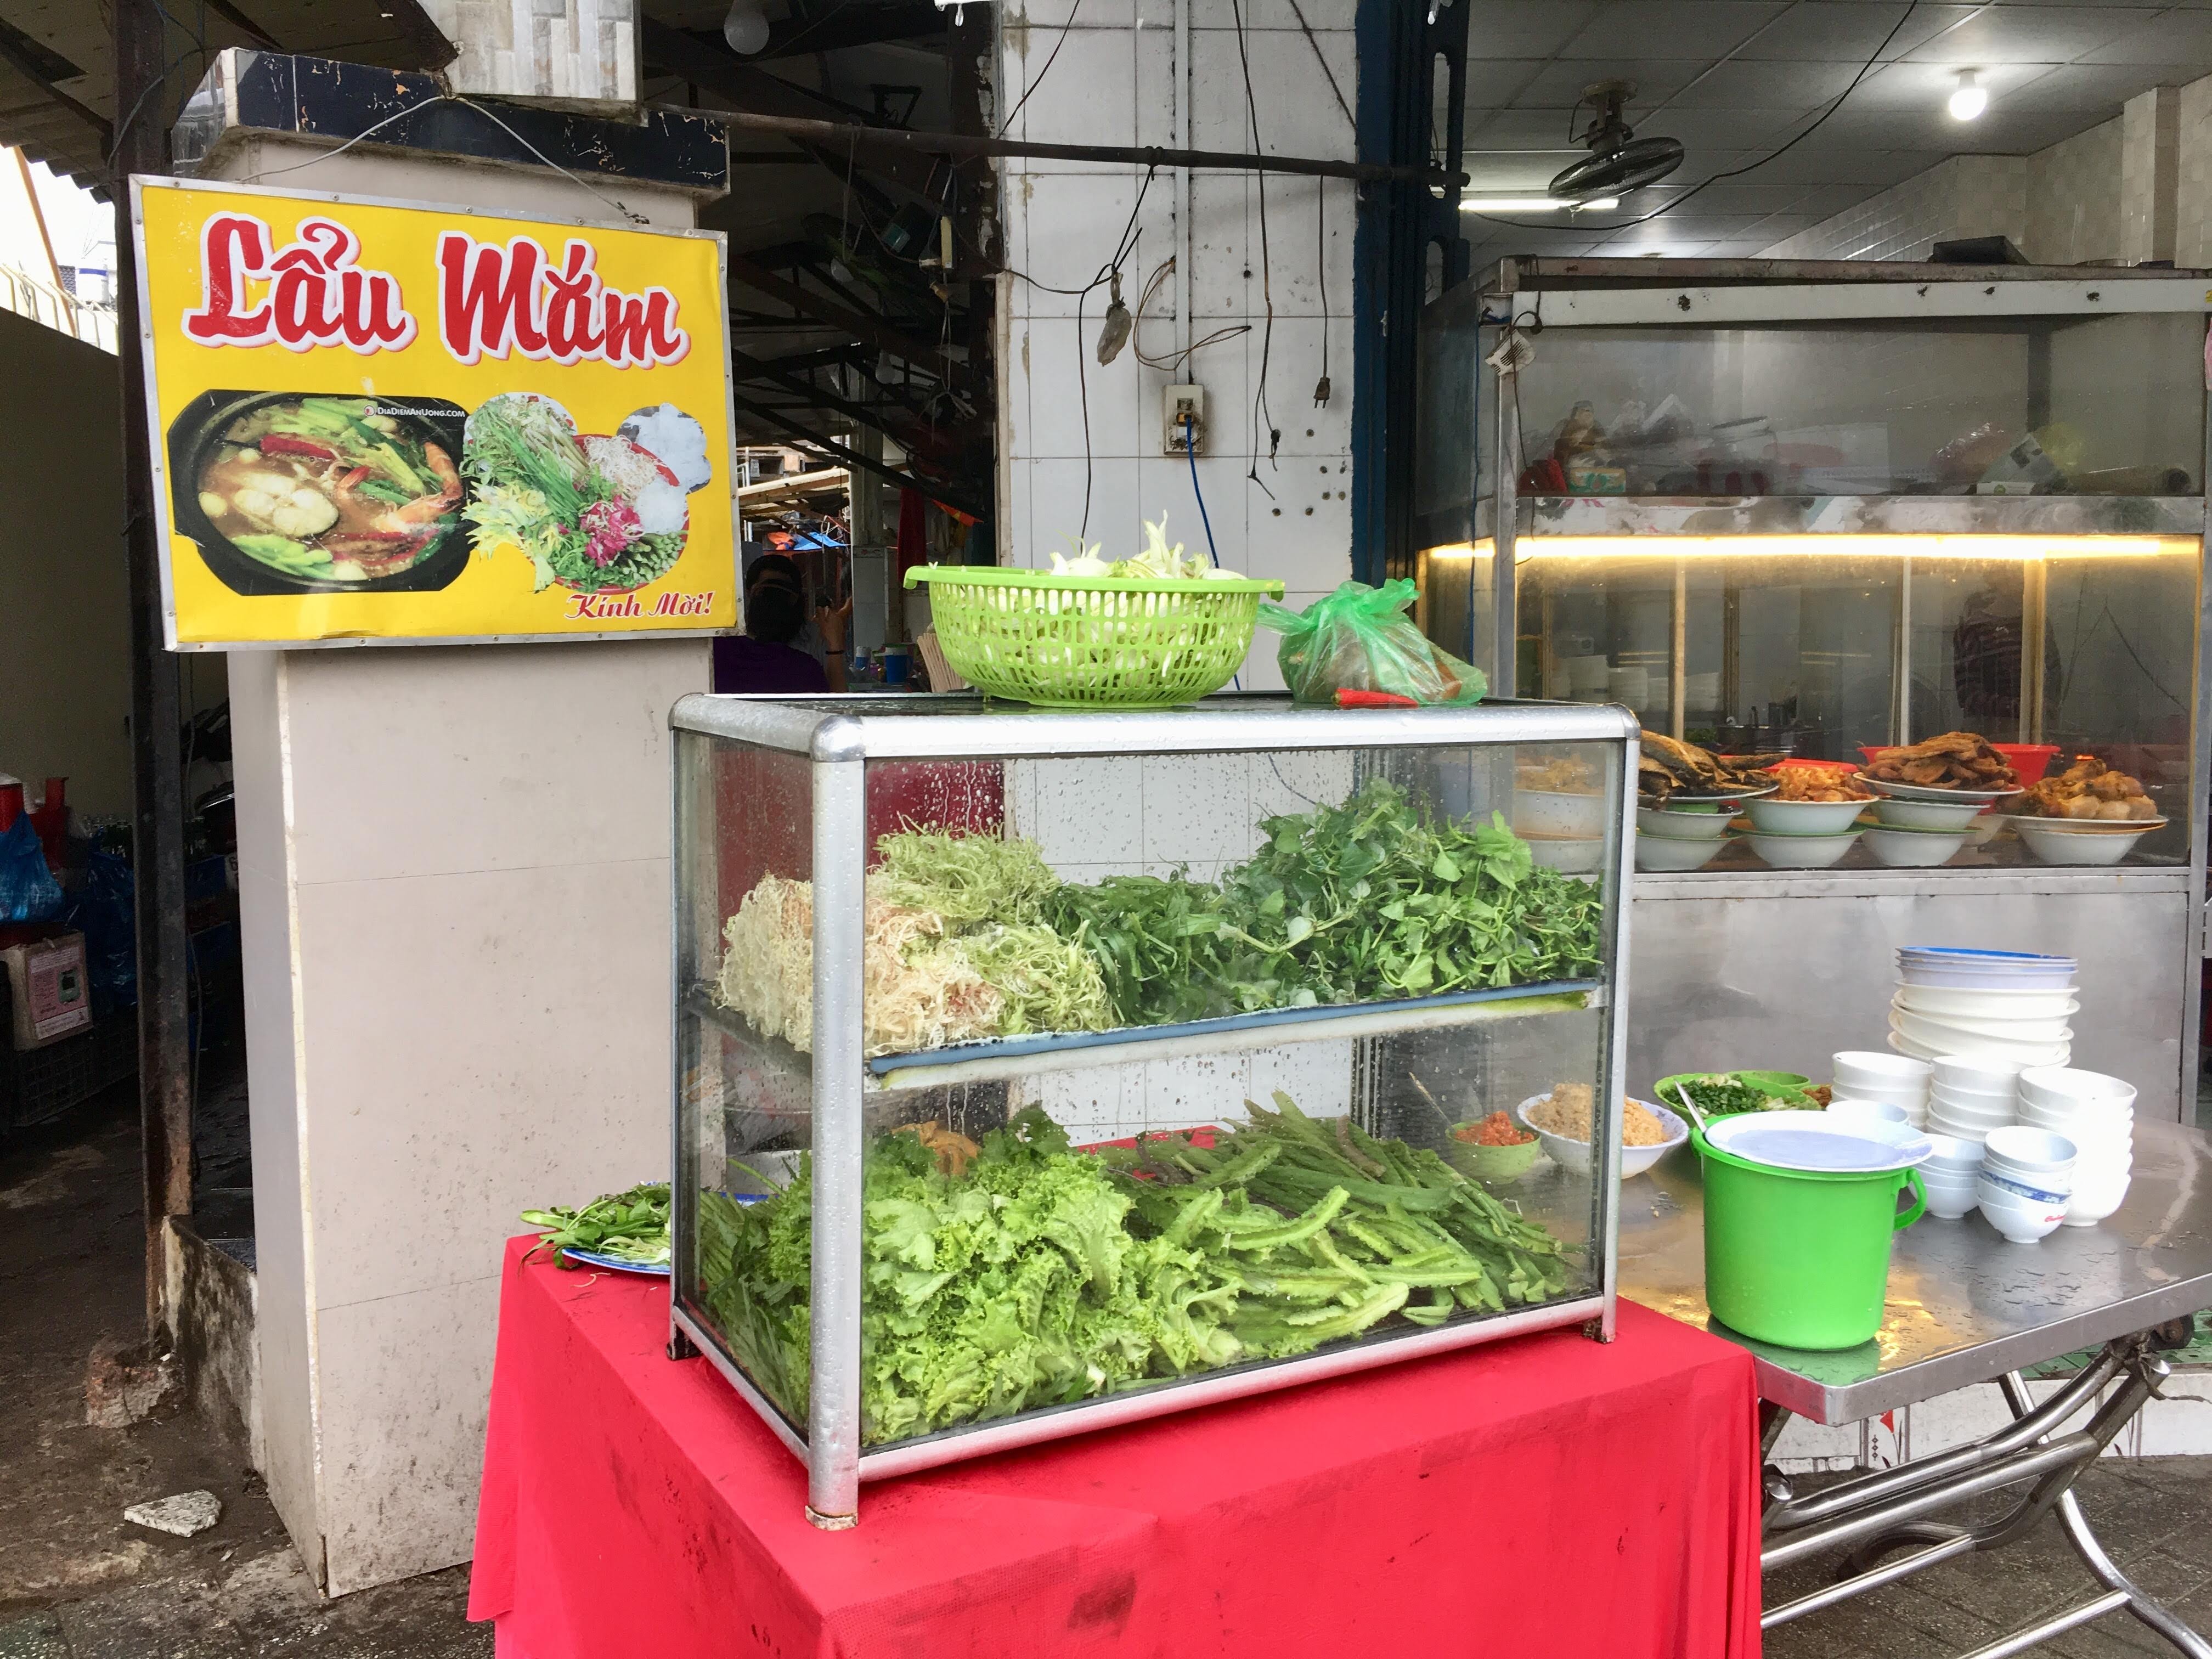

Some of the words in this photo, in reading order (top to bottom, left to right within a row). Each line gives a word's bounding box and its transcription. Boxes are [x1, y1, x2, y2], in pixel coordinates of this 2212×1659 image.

[185, 215, 413, 351] Lẩu
[438, 235, 686, 366] Mắm
[565, 593, 644, 618] Kính
[648, 592, 714, 617] Mời!
